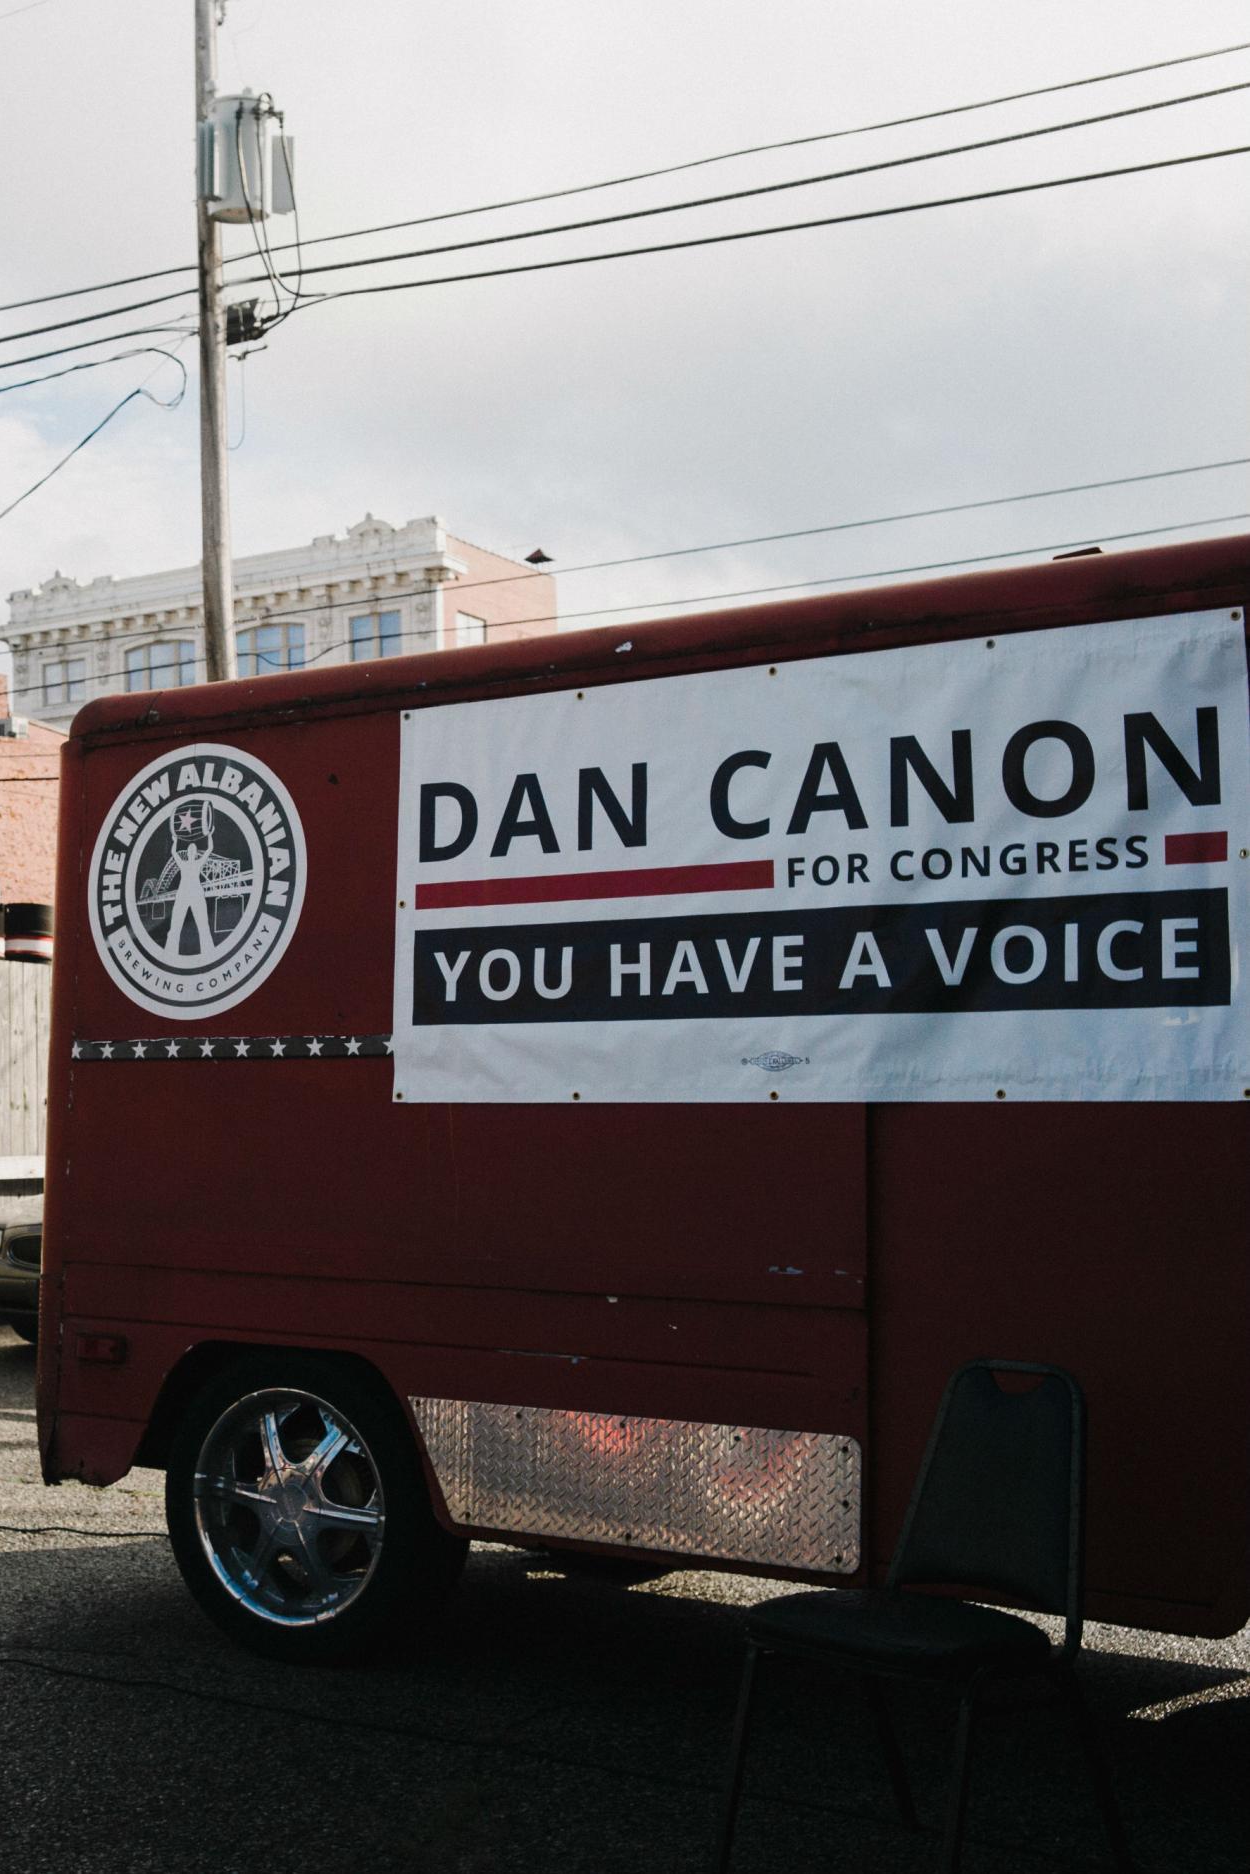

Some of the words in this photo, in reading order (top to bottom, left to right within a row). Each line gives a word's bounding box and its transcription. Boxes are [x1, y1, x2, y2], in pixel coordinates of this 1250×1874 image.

[418, 761, 648, 863] DAN
[709, 706, 1221, 840] CANON
[102, 850, 126, 927] THE
[114, 772, 171, 846] NEW
[176, 762, 290, 907] ALBANIAN
[787, 852, 870, 888] FOR
[888, 834, 1150, 881] CONGRESS
[117, 938, 184, 993] BREWING
[196, 924, 271, 992] COMPANY
[433, 944, 575, 1002] YOU
[609, 933, 806, 998] HAVE
[839, 929, 892, 990] A
[924, 916, 1202, 987] VOICE
